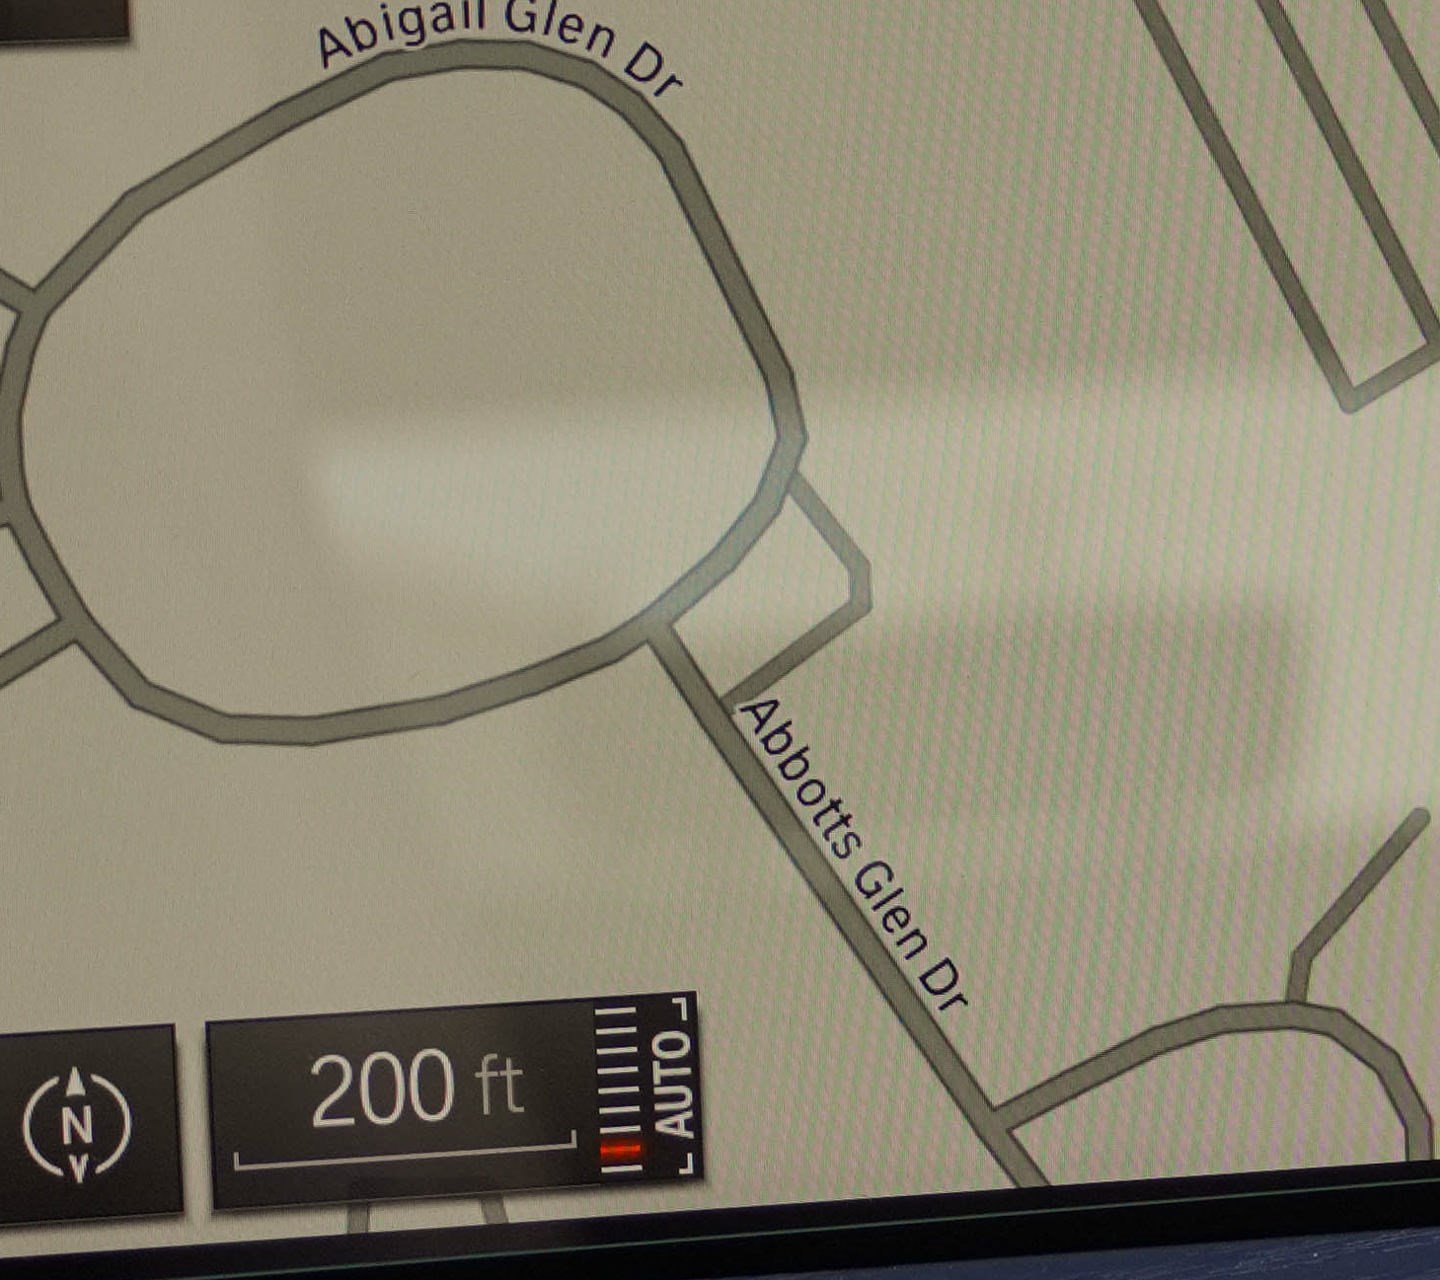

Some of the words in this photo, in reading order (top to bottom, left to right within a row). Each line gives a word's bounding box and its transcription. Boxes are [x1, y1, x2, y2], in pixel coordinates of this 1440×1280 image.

[623, 41, 685, 99] Dr
[739, 698, 862, 860] Abbotts
[854, 860, 928, 961] Glen
[917, 956, 970, 1012] Dr
[61, 1104, 94, 1146] N
[310, 1047, 456, 1129] 200
[473, 1052, 526, 1116] ft
[650, 1028, 697, 1141] AUTO
